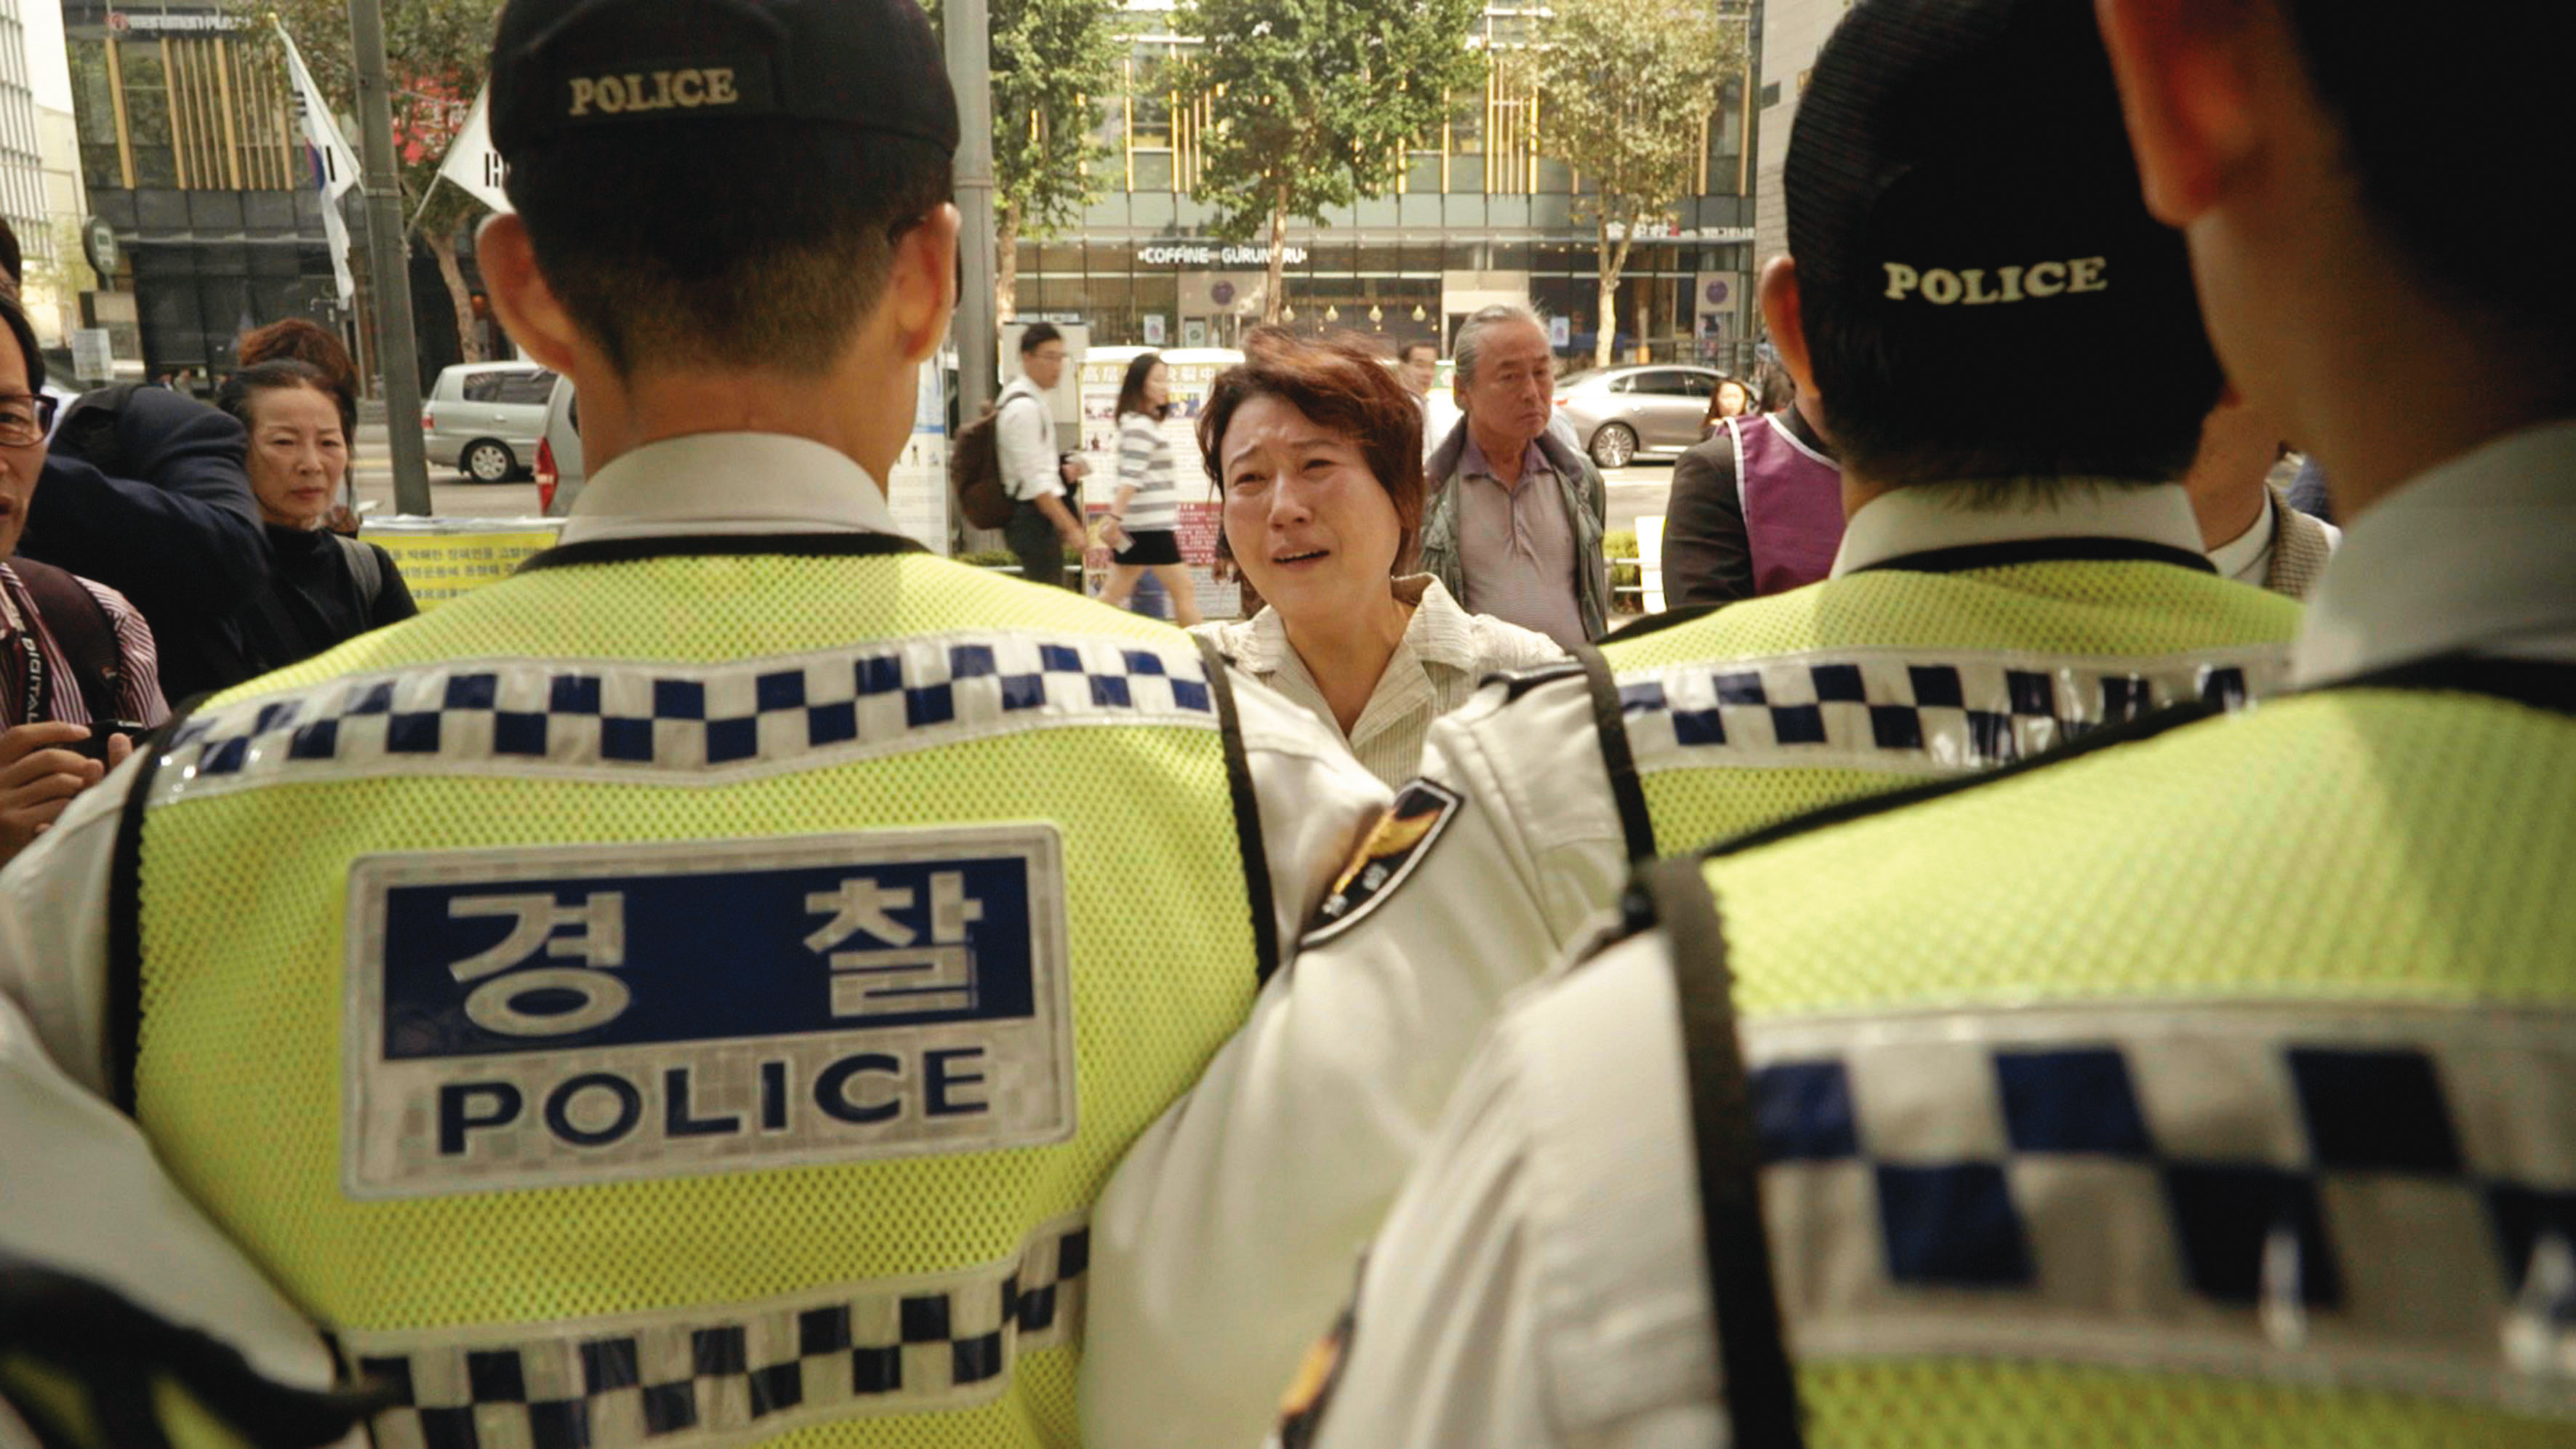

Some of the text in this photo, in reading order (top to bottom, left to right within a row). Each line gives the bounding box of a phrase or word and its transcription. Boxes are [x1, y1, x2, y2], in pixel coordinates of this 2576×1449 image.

[569, 68, 739, 116] POLICE
[1221, 245, 1302, 264] GURUNRU
[1882, 256, 2108, 305] POLICE
[22, 637, 42, 723] DIGITAL
[447, 871, 983, 1037] 경찰
[439, 1046, 990, 1156] POLICE
